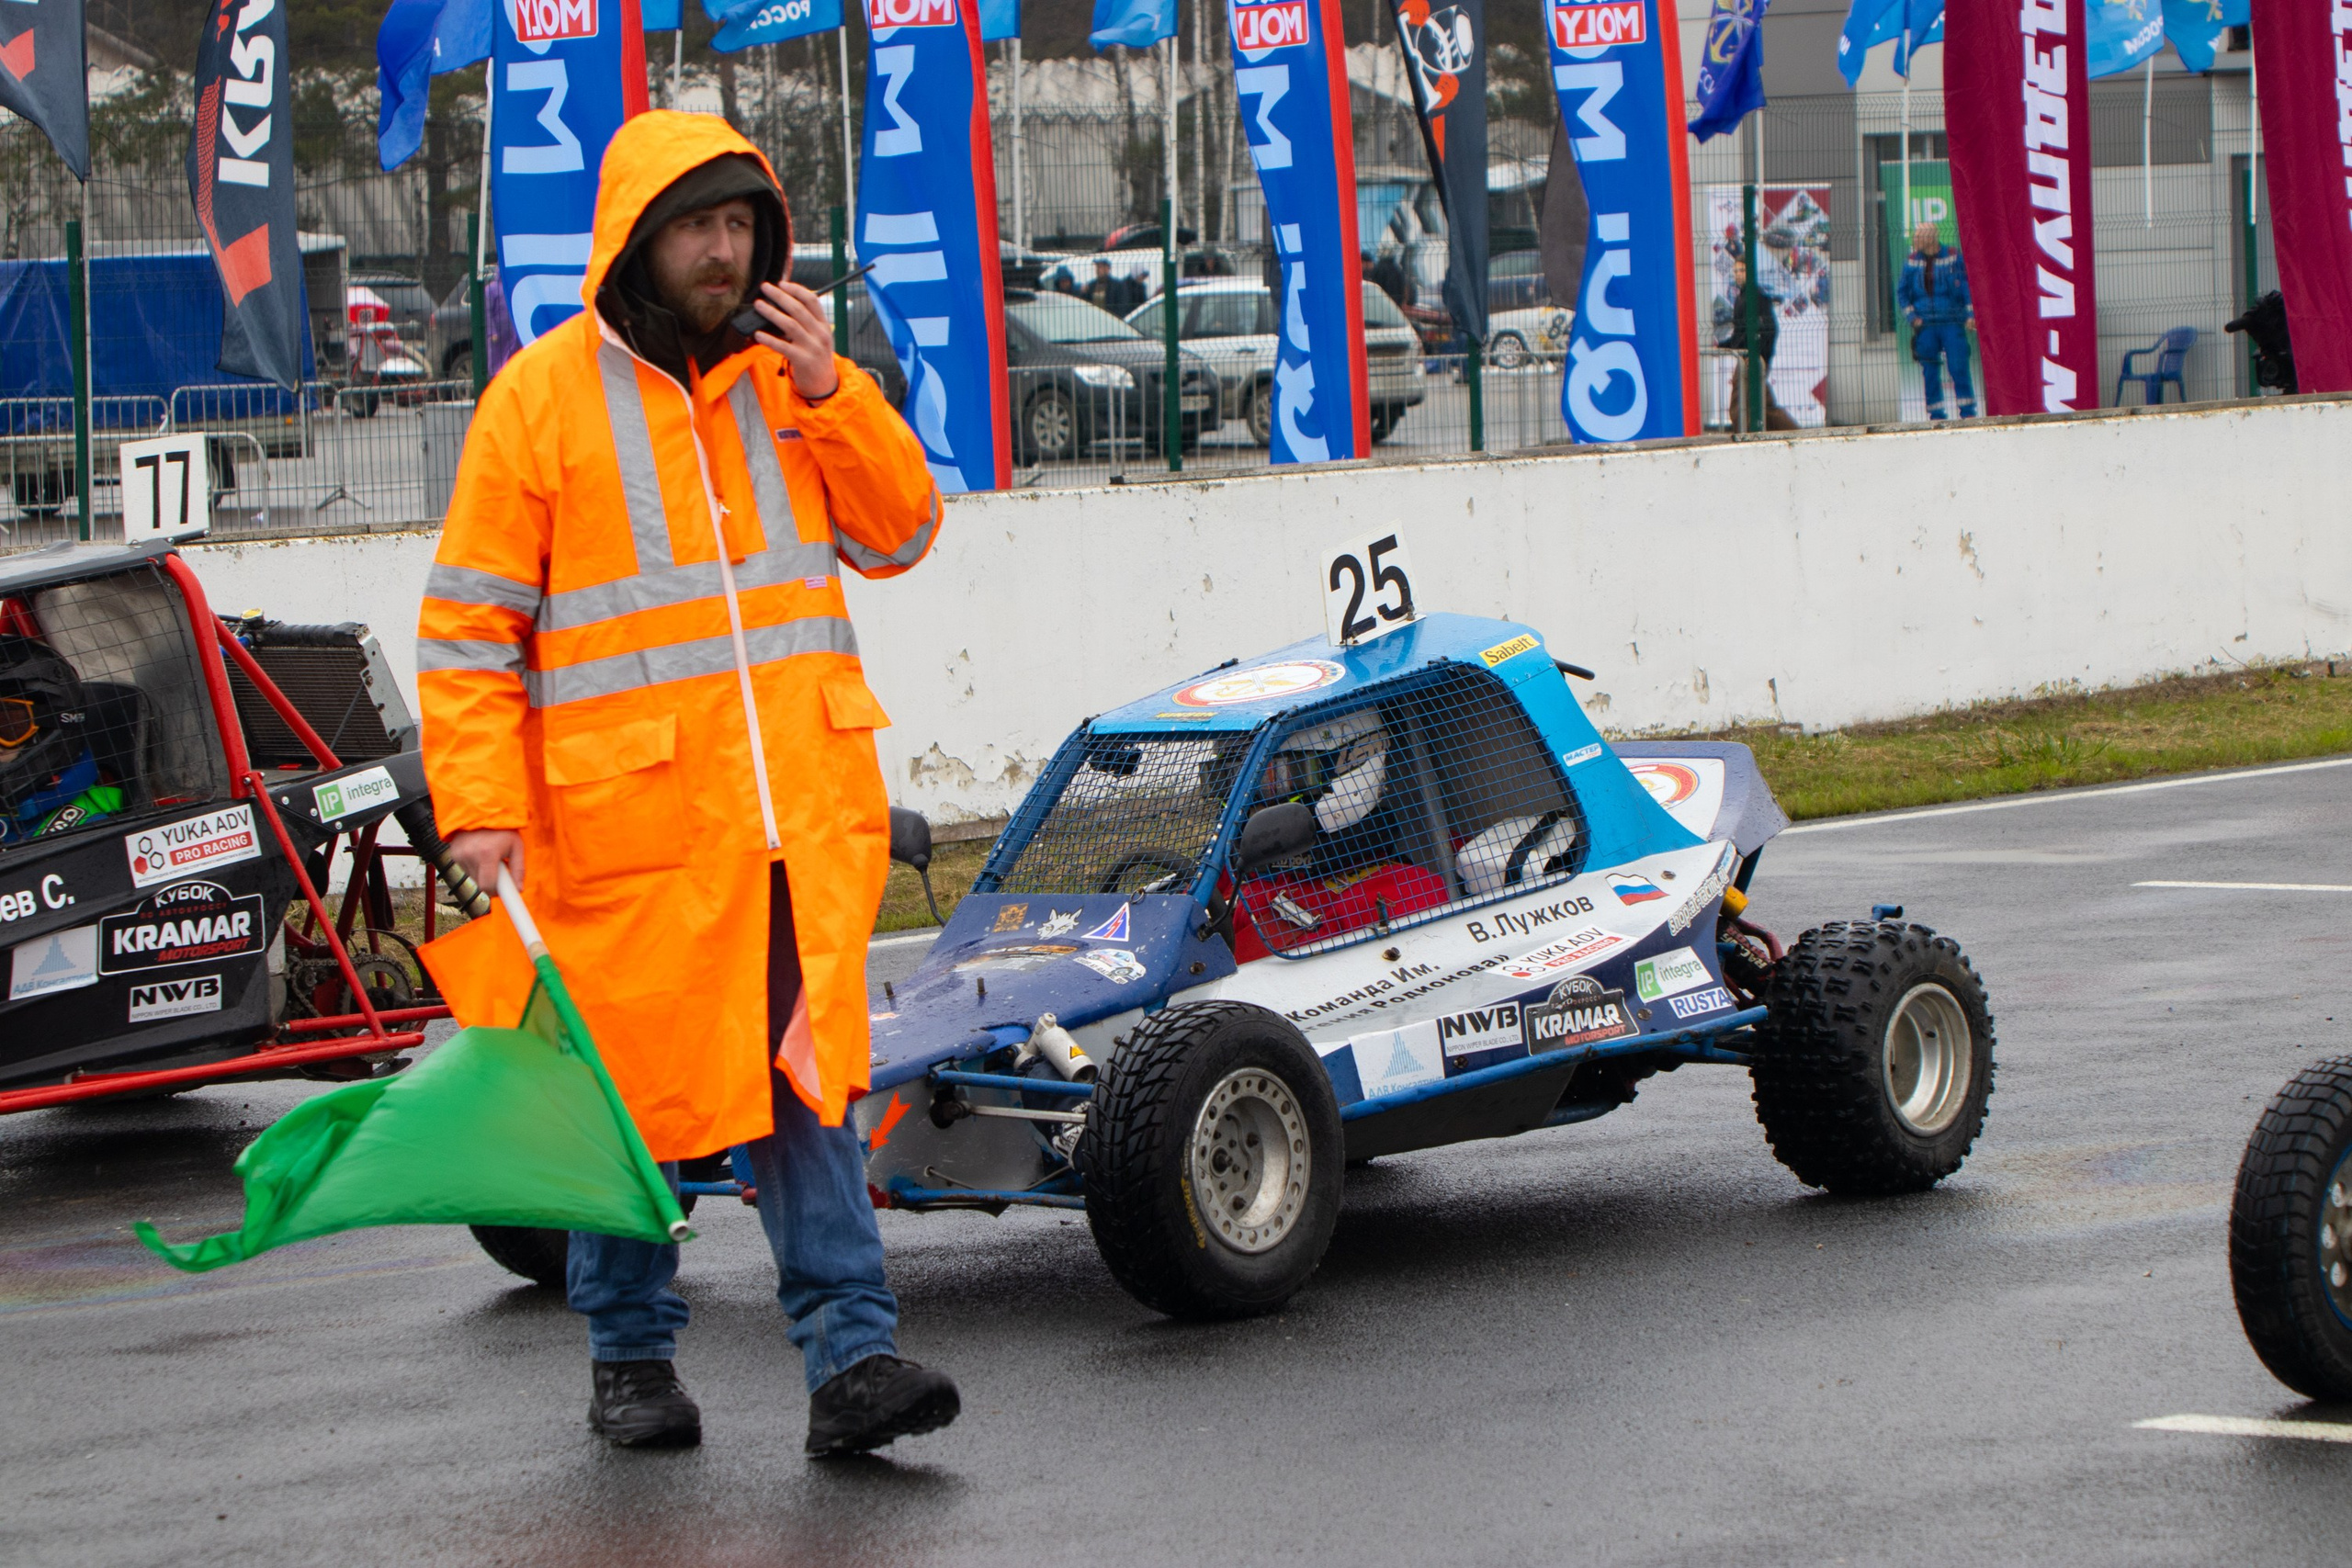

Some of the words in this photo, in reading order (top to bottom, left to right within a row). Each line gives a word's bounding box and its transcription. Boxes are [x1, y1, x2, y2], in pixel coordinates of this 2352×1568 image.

[135, 450, 190, 529] 77
[1329, 534, 1413, 640] 25
[1485, 637, 1533, 663] Sabelt
[1565, 744, 1600, 762] МАСТЕР
[322, 791, 339, 812] IP
[346, 778, 392, 800] integra
[162, 819, 212, 846] YUKA
[217, 809, 248, 833] ADV
[175, 847, 201, 863] PRO
[202, 835, 248, 855] RACING
[0, 890, 37, 922] ев
[154, 885, 215, 908] КУБОК
[114, 910, 251, 955] KRAMAR
[1521, 944, 1571, 964] YUKA
[1572, 927, 1604, 948] ADV
[157, 937, 251, 962] MOTORSPORT
[1550, 953, 1575, 967] PRO
[1577, 938, 1616, 958] RACING
[1659, 959, 1702, 982] integra
[132, 978, 220, 1008] NWB
[1284, 979, 1396, 1022] Команда
[1559, 980, 1594, 999] КУБОК
[1673, 989, 1732, 1016] RUSTA
[1443, 1006, 1519, 1038] NWB
[1534, 1004, 1623, 1041] KRAMAR
[1565, 1024, 1627, 1045] MOTORSPORT
